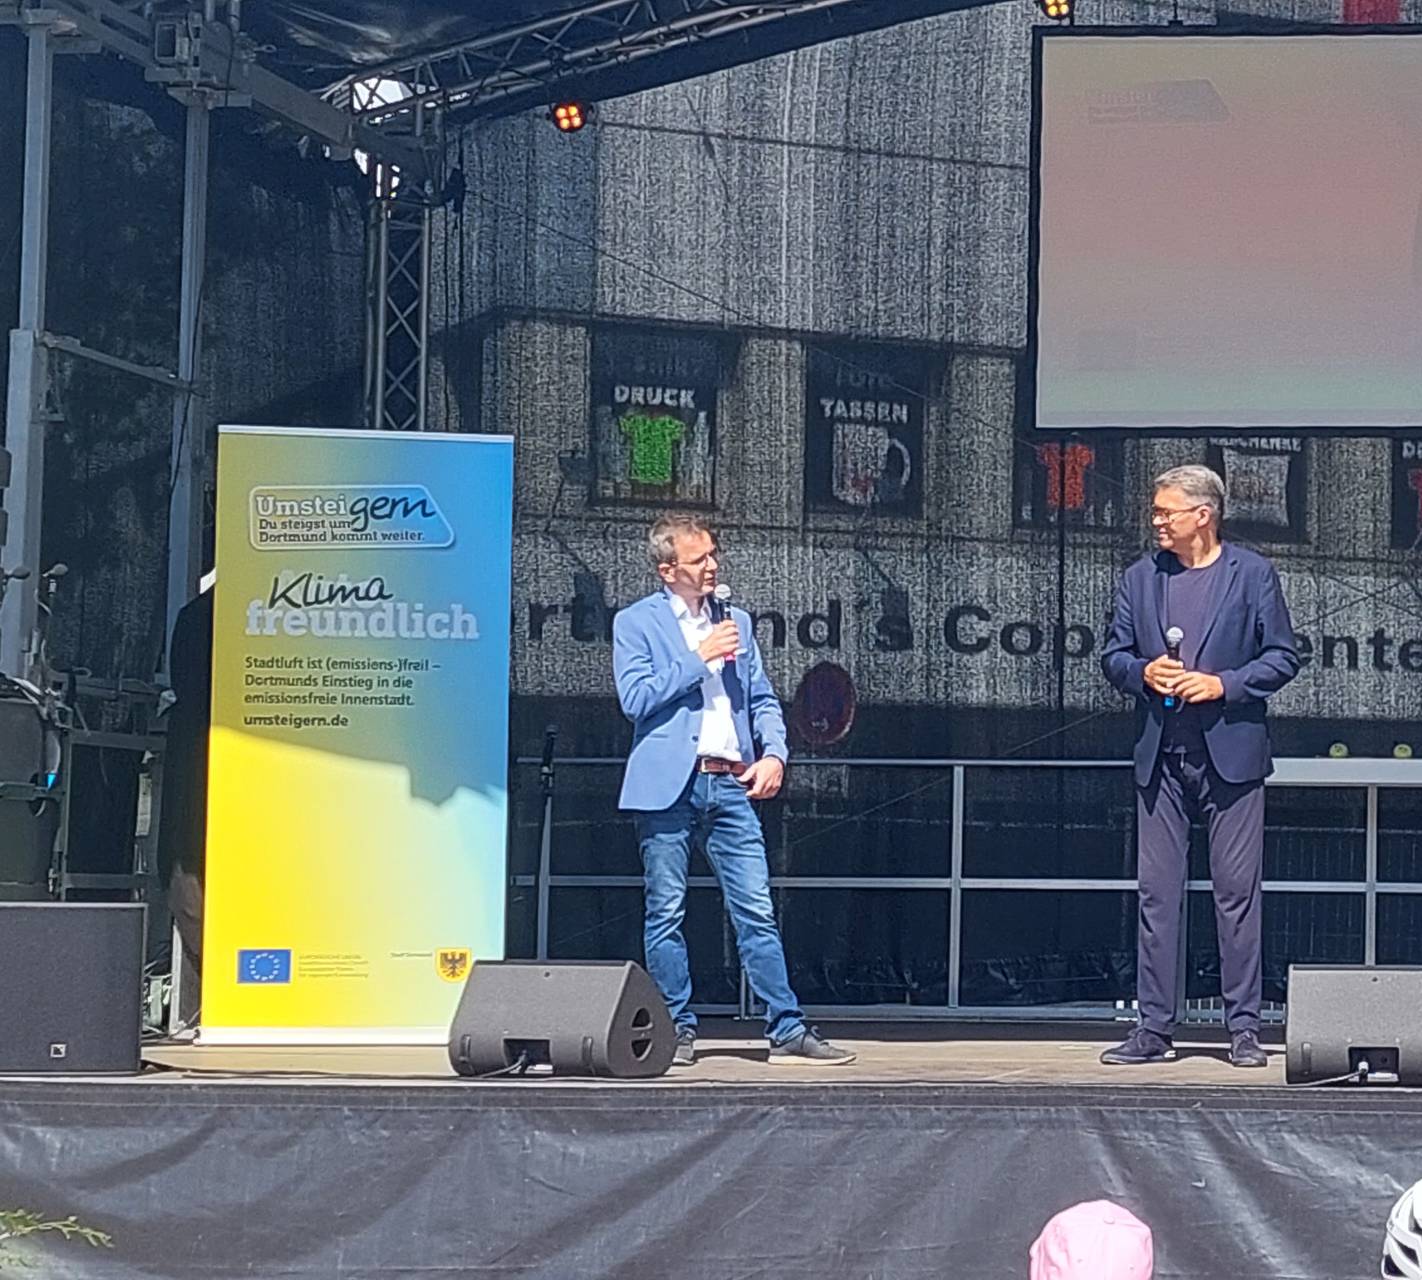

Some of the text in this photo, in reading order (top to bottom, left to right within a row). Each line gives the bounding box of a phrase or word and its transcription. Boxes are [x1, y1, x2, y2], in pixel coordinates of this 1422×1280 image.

[614, 385, 696, 409] DRUCK
[820, 399, 908, 424] TASSEN
[256, 494, 436, 532] Umsteigern
[259, 518, 351, 531] Du steigst um
[259, 528, 425, 543] Dortmund kommt weiter.
[268, 572, 394, 609] Klima
[245, 599, 480, 640] freundlich
[944, 604, 1108, 658] Cop
[245, 656, 304, 669] Stadtluft
[307, 657, 323, 669] ist
[326, 657, 429, 672] (emissions-)frei!
[245, 674, 413, 690] Dortmunds Einstieg in die
[244, 692, 415, 706] emissionsfreie Innenstadt.
[244, 714, 348, 728] umsteigern.de
